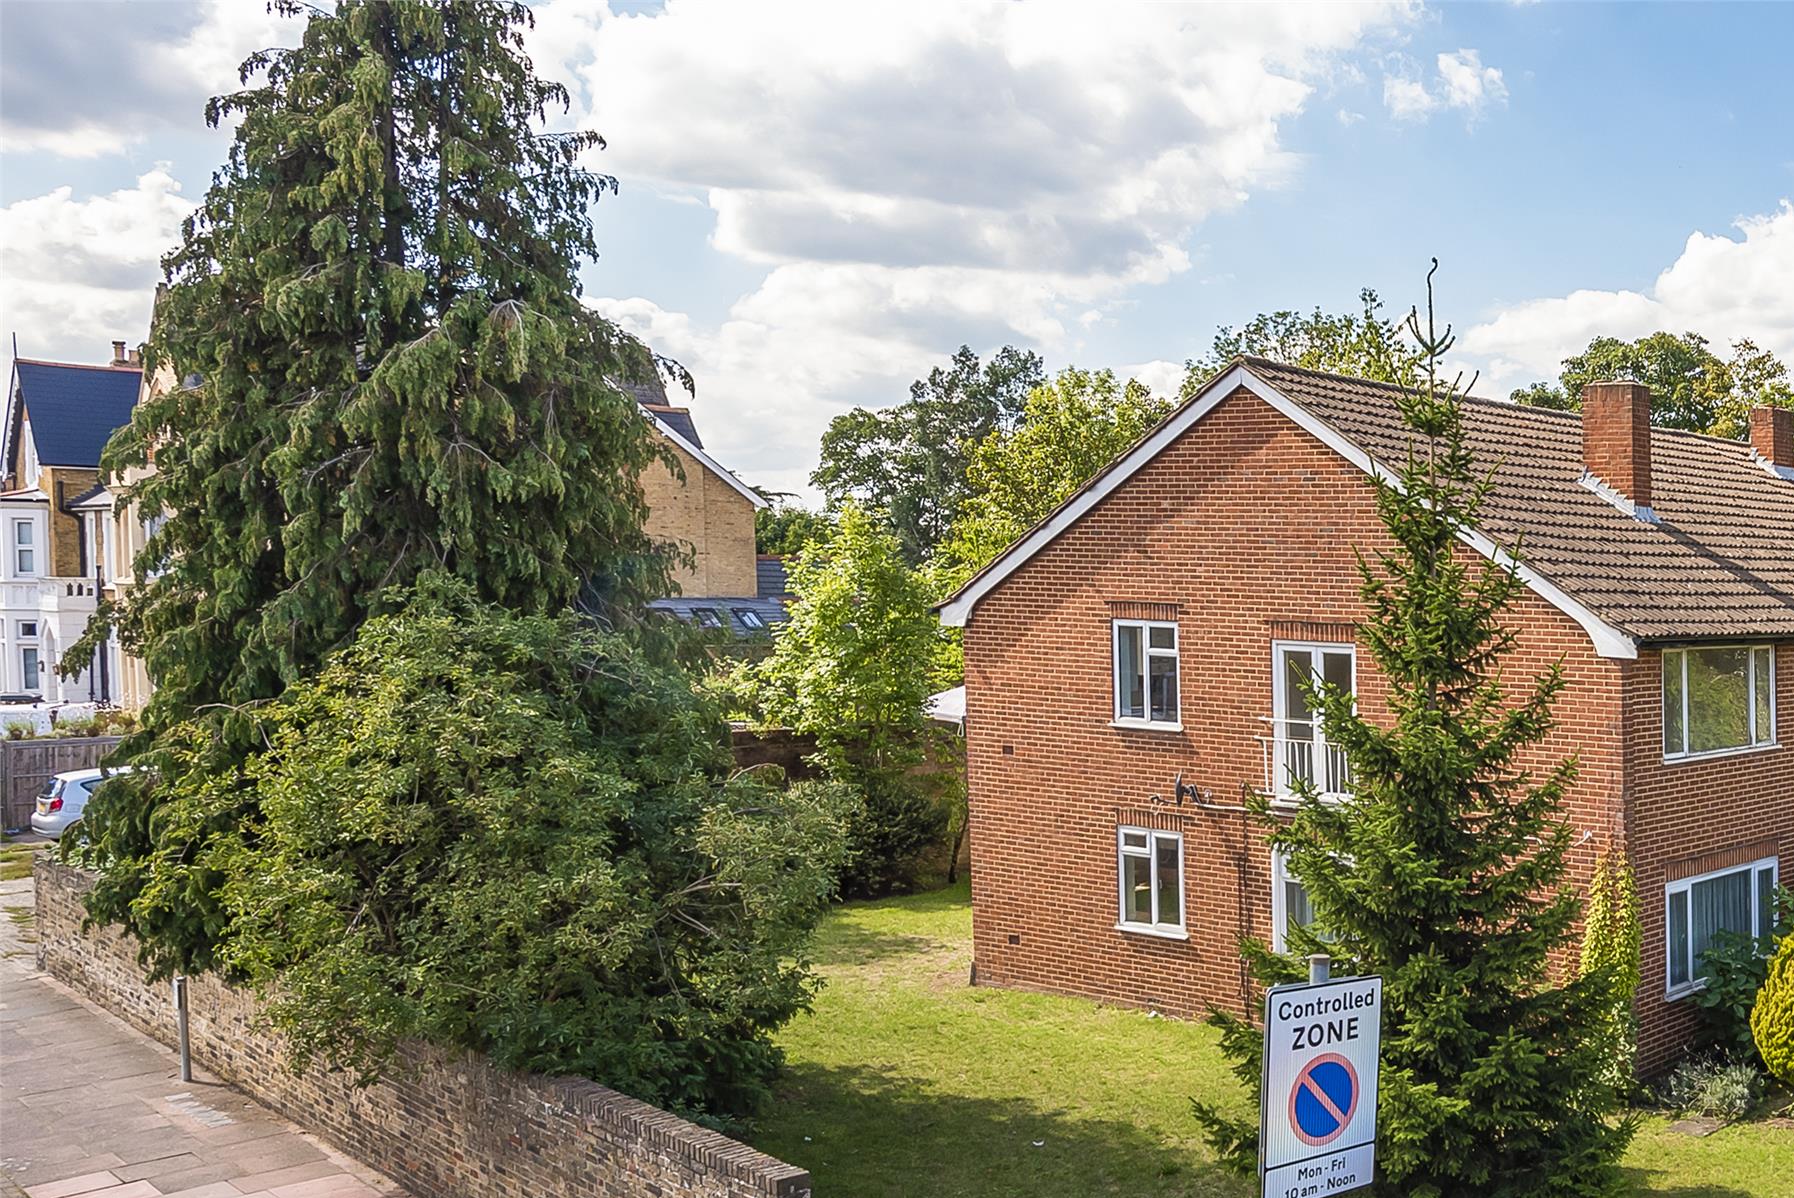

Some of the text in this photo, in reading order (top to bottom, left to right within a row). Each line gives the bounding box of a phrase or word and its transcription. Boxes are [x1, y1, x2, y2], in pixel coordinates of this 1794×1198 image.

[1279, 988, 1375, 1021] Controlled
[1292, 1017, 1359, 1051] ZONE
[1298, 1165, 1322, 1181] Mon
[1331, 1157, 1346, 1174] Fri
[1301, 1184, 1318, 1198] am
[1327, 1173, 1356, 1191] Noon
